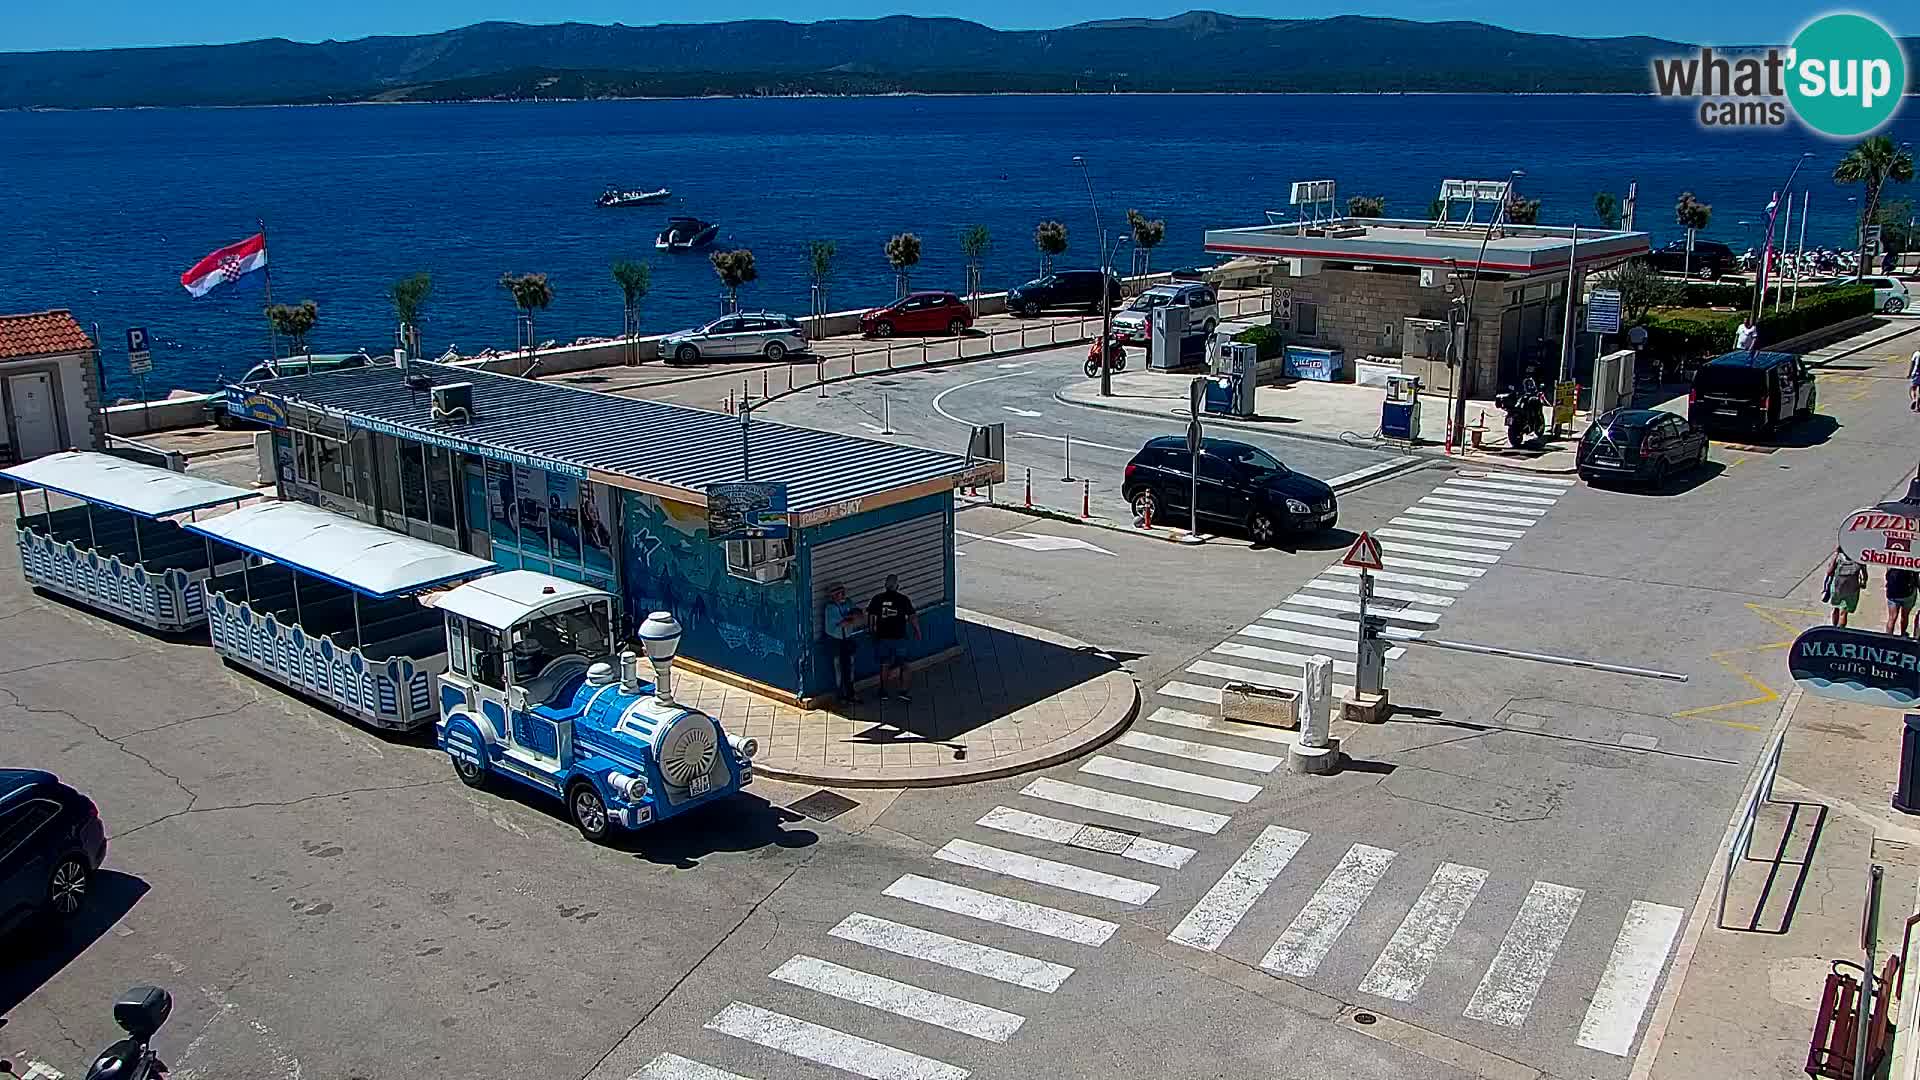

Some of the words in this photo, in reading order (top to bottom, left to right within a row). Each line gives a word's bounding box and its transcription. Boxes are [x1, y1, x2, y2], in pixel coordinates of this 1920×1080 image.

[131, 330, 143, 349] P
[438, 439, 469, 451] POSTAJA
[480, 447, 494, 457] BUS
[495, 450, 527, 465] STATION
[529, 457, 555, 470] TICKET
[556, 462, 583, 477] OFFICE
[1848, 514, 1920, 532] PIZZE
[1829, 661, 1867, 675] caffe
[1871, 665, 1898, 680] bar
